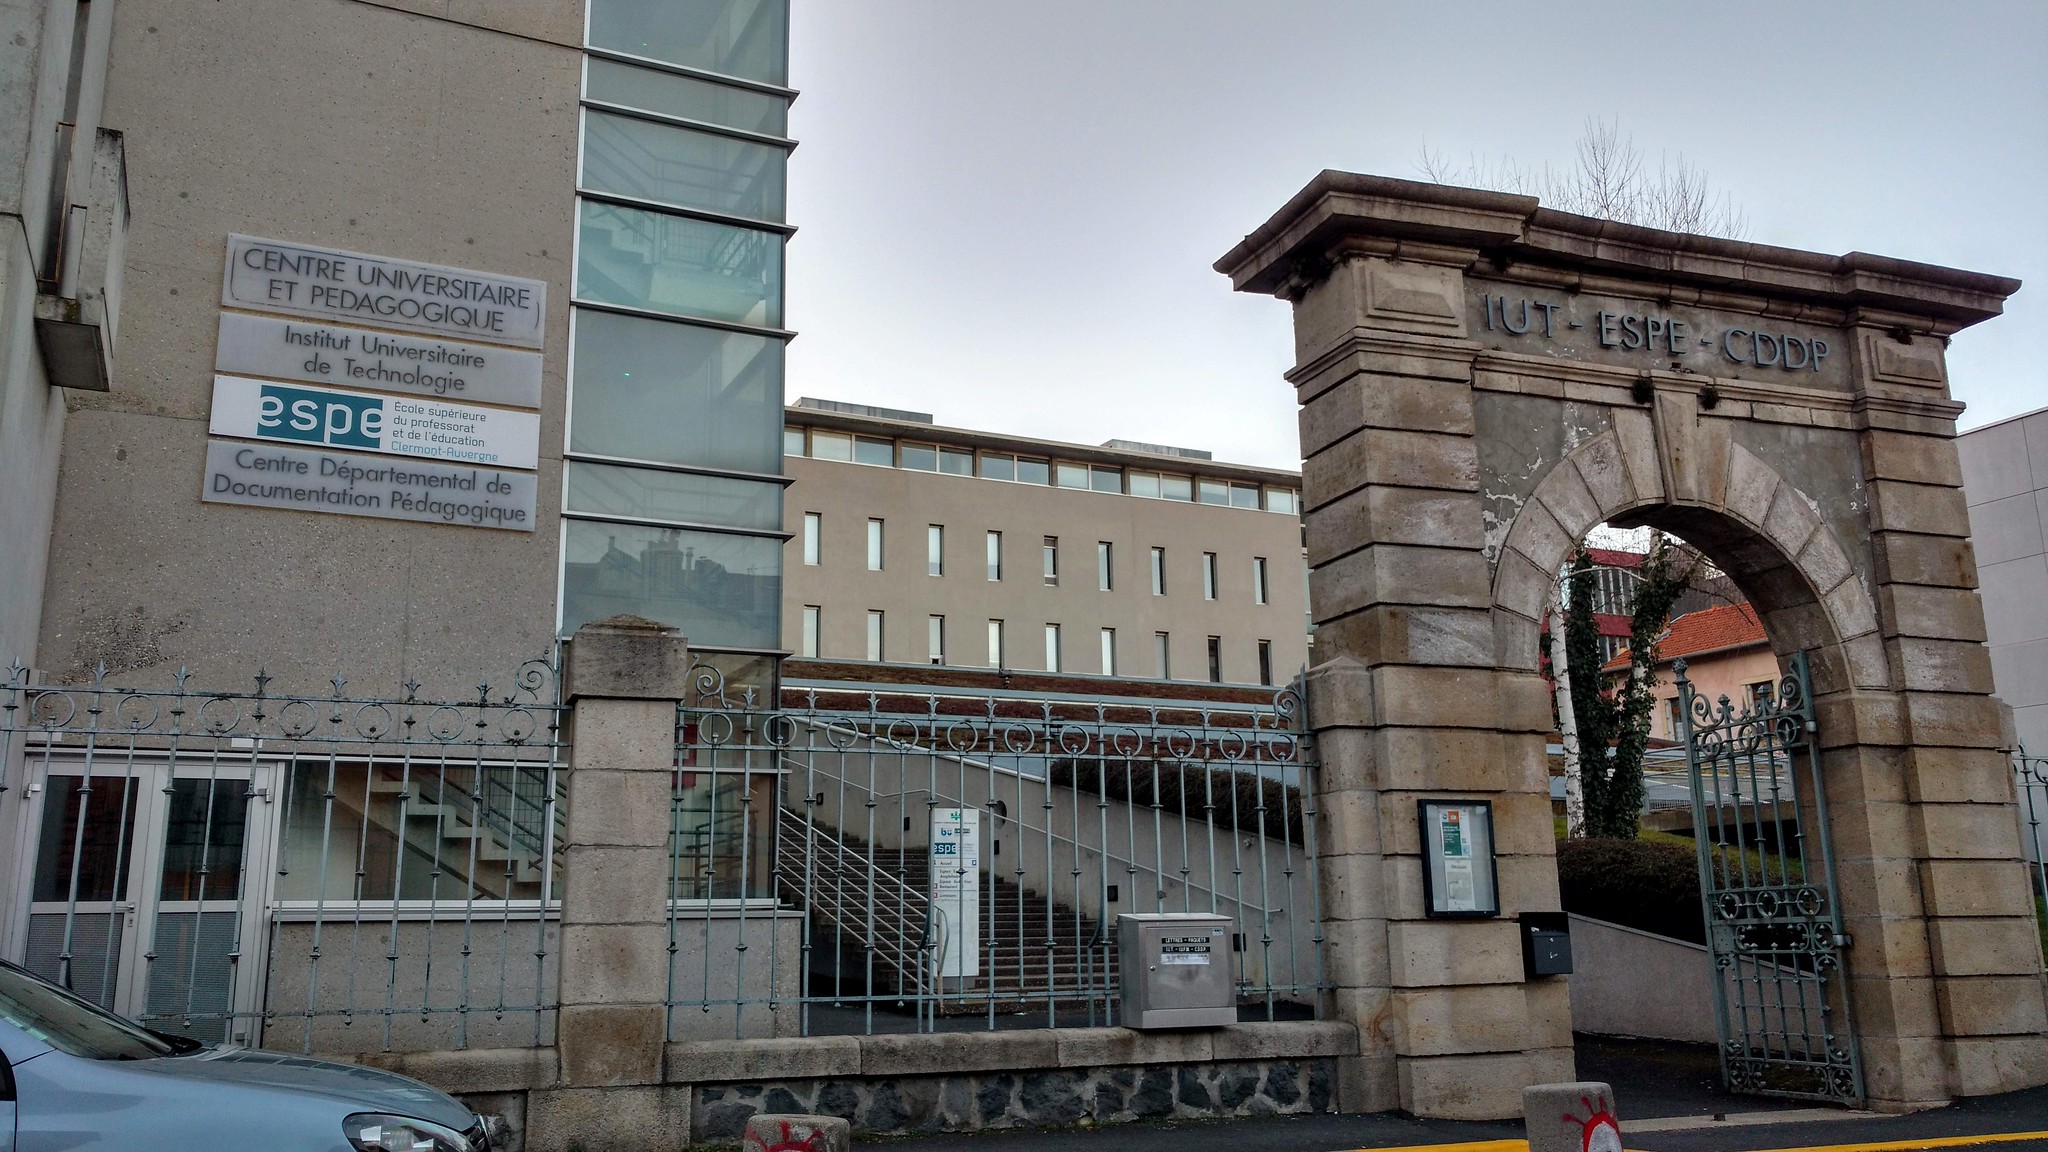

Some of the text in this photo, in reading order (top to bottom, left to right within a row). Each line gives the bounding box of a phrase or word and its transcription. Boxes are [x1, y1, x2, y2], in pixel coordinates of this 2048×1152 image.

[244, 248, 530, 309] CENTRE UNIVERSITAIRE
[268, 279, 504, 332] ET PEDAGOGIQUE
[286, 325, 485, 368] Institut Universitaire
[1485, 295, 1561, 338] IUT
[1599, 310, 1686, 355] ESPE
[1724, 326, 1830, 372] CDDP
[304, 353, 465, 394] de Technologie
[258, 395, 383, 444] espe
[393, 415, 475, 433] du professorat
[394, 401, 486, 422] École supérieure
[391, 441, 498, 462] Clermont-Auvergne
[392, 428, 485, 447] et de l'éducation
[235, 449, 512, 495] Centre Départemental de
[213, 473, 526, 526] Documentation Pédagogique
